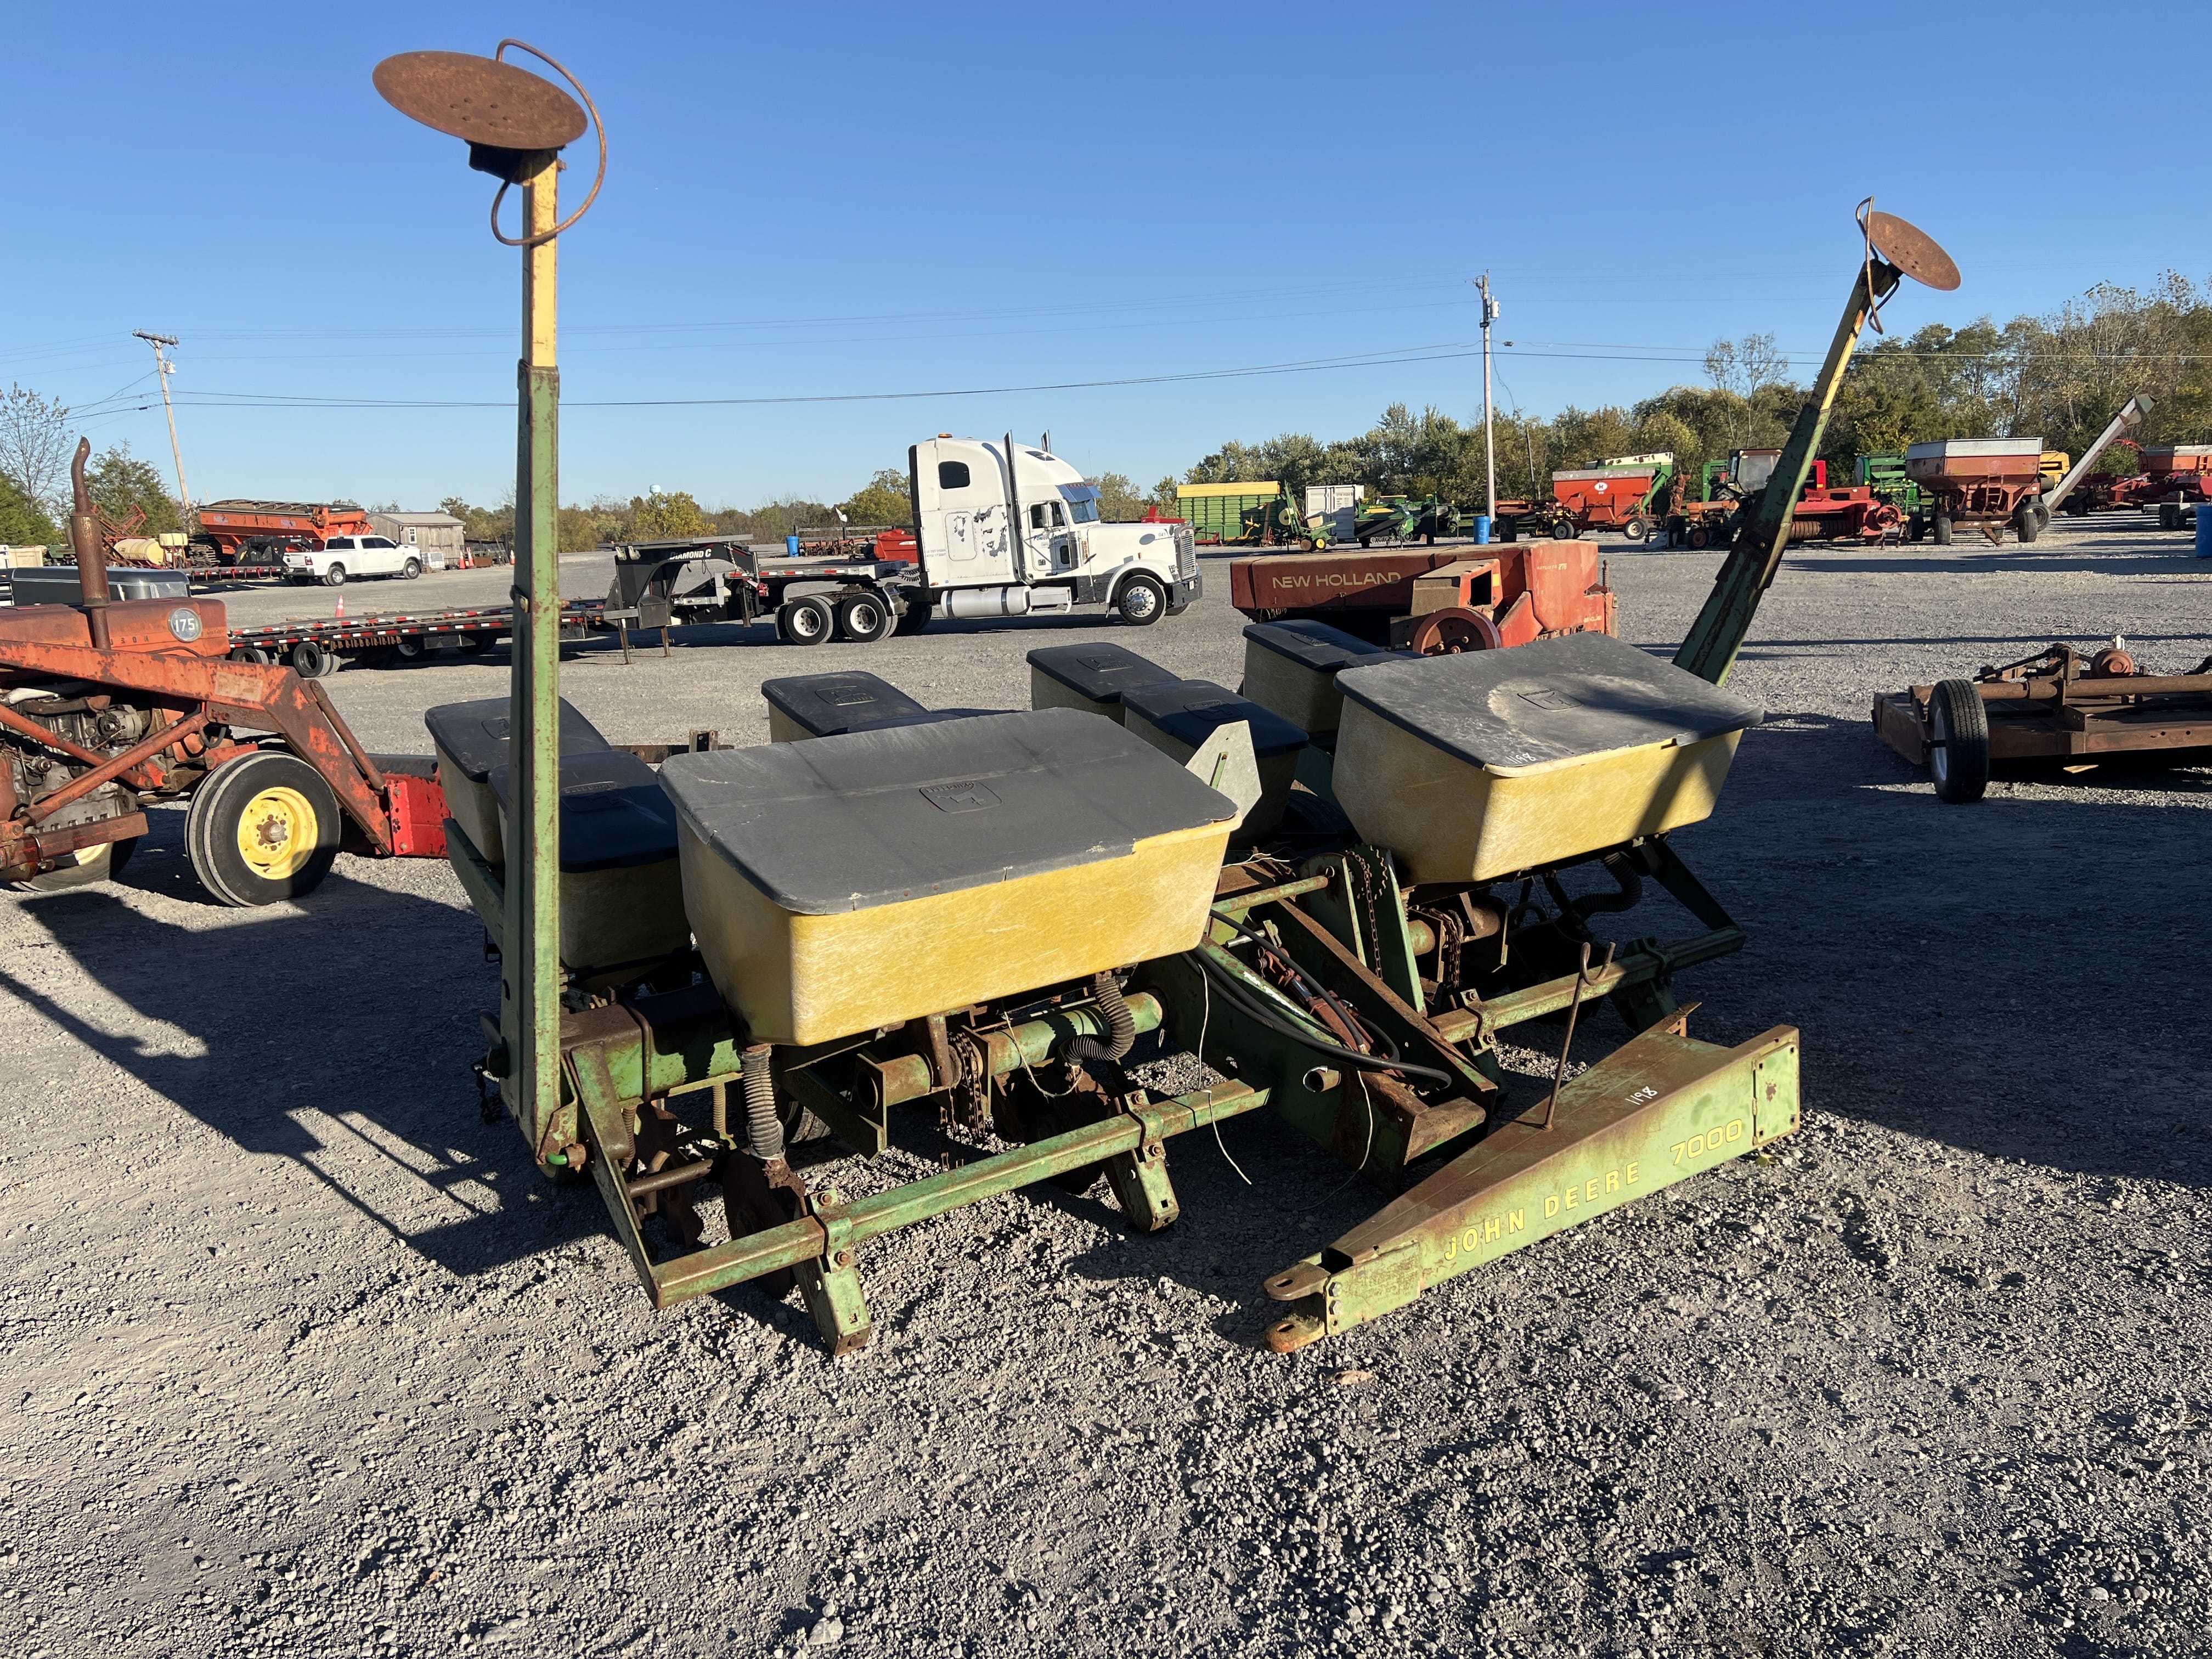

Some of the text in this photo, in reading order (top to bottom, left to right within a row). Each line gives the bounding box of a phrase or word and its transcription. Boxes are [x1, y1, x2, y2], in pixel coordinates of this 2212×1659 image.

[1272, 572, 1401, 589] NEW HOLLAND
[175, 618, 195, 633] 175
[1505, 752, 1537, 764] 1198
[1624, 1086, 1658, 1105] 1198
[1444, 1118, 1742, 1261] JOHN DEERE 7000
